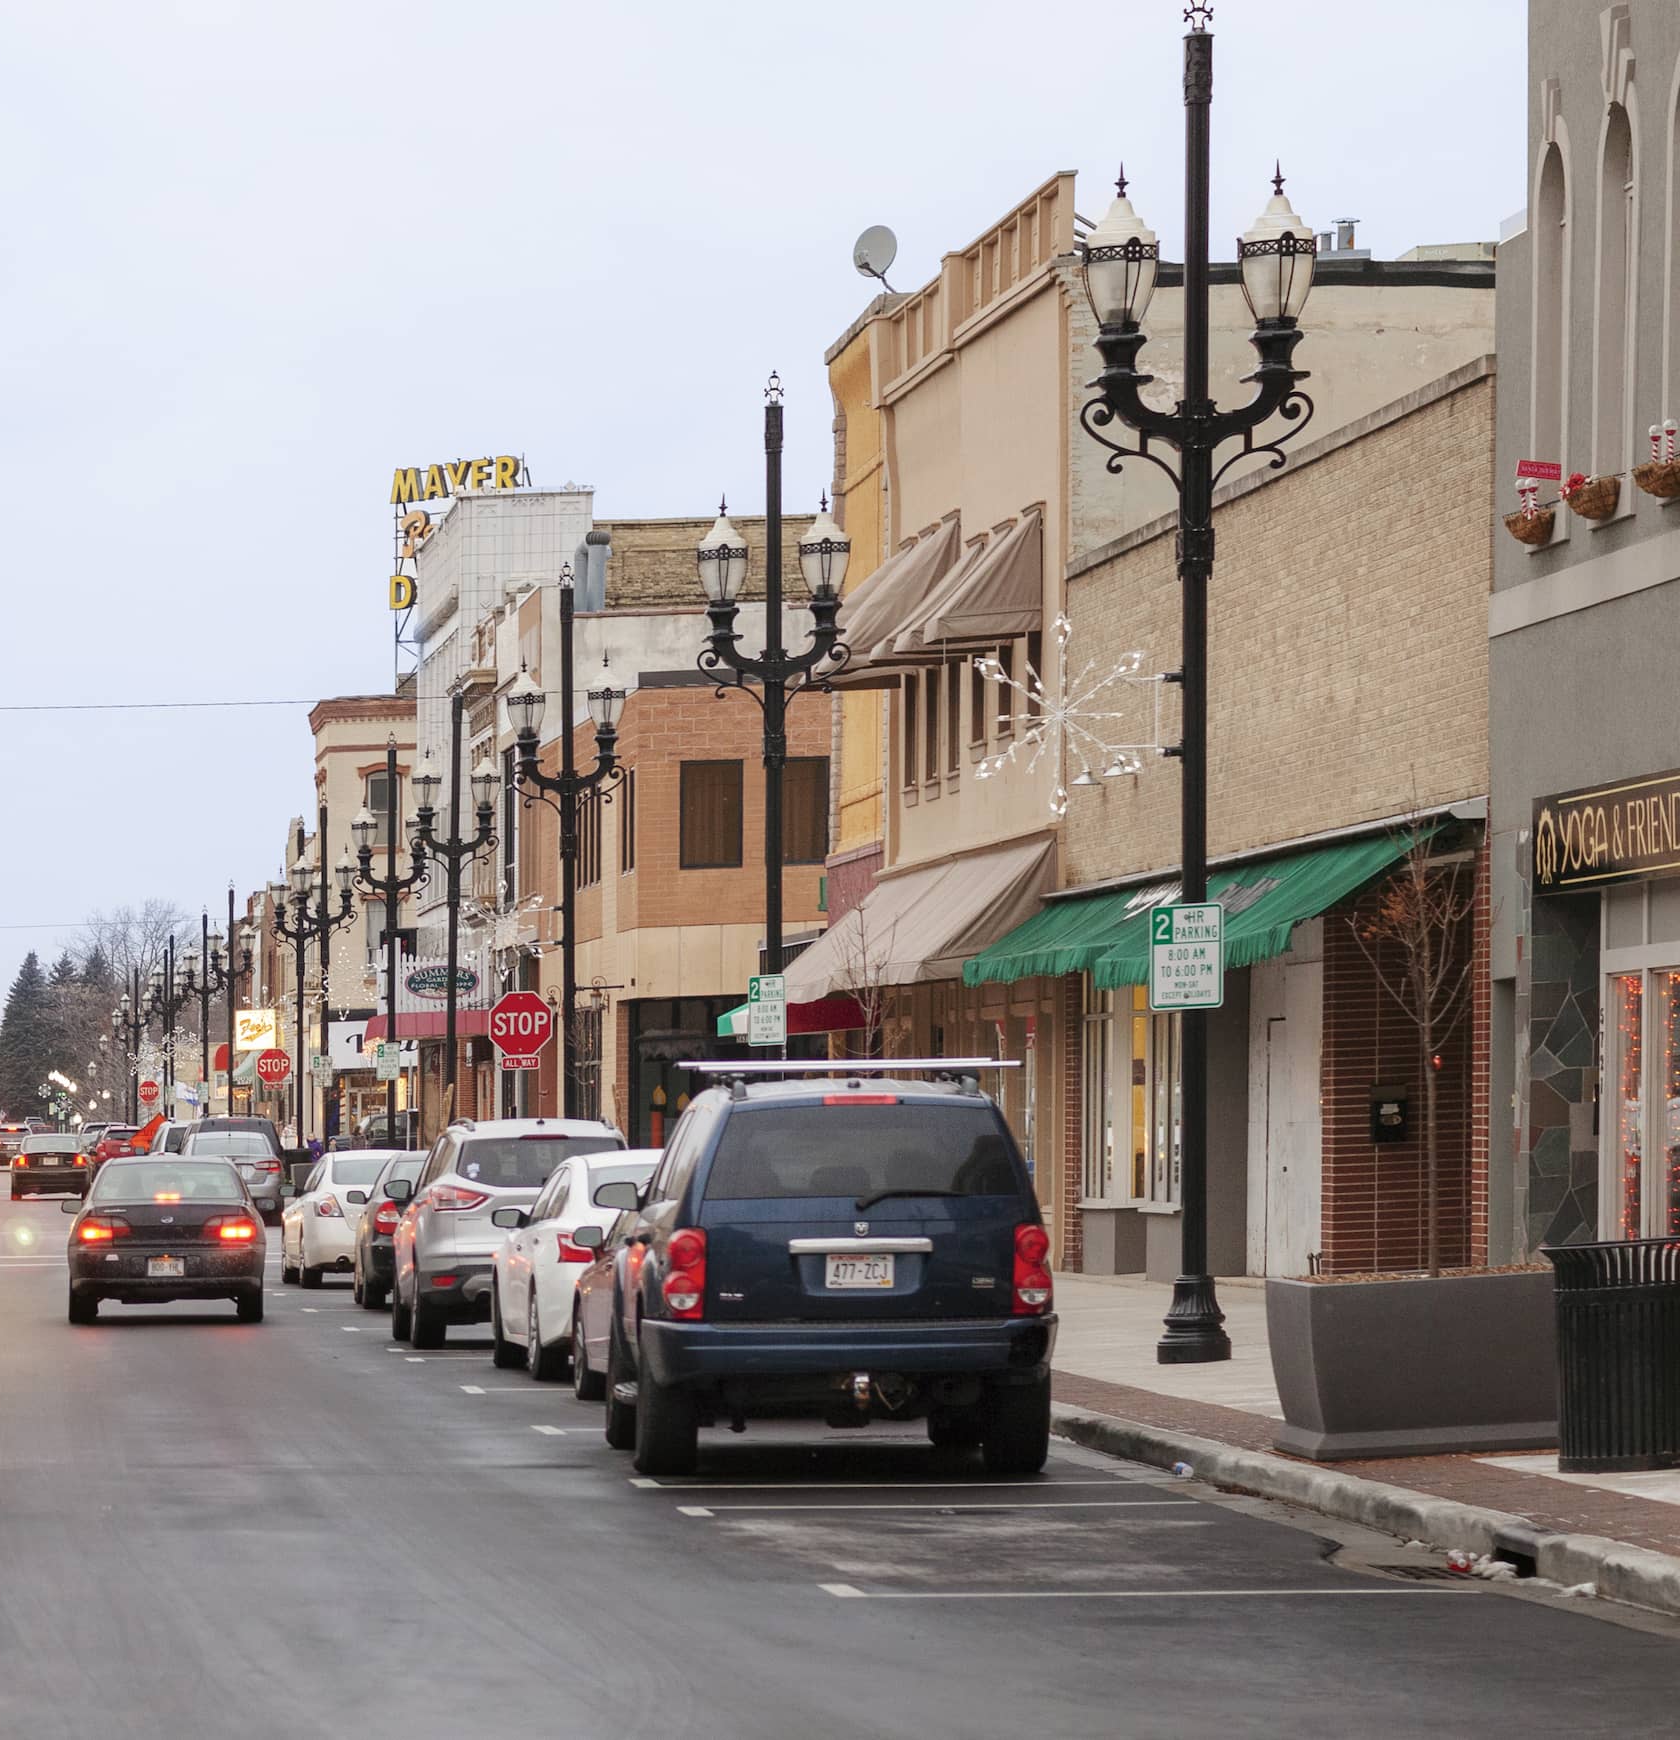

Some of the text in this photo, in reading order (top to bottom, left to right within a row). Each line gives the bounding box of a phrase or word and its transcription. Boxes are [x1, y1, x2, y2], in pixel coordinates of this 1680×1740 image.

[390, 455, 518, 504] MAYER
[1559, 806, 1609, 873] YOGA
[1613, 804, 1624, 860] &
[1155, 910, 1204, 940] 2 HR
[1175, 925, 1218, 939] PARKING
[1168, 948, 1206, 960] 8:00 AM
[414, 968, 470, 982] SUMMRS
[1161, 964, 1213, 977] TO 6:00 PM
[443, 981, 473, 989] SPPE
[751, 982, 759, 999] 2
[493, 1011, 548, 1036] STOP
[378, 1045, 384, 1057] 2
[258, 1058, 289, 1073] STOP
[314, 1056, 320, 1068] 2
[505, 1059, 537, 1067] ALL WAY
[139, 1085, 158, 1096] STOP
[833, 1262, 888, 1280] 477-ZCJ
